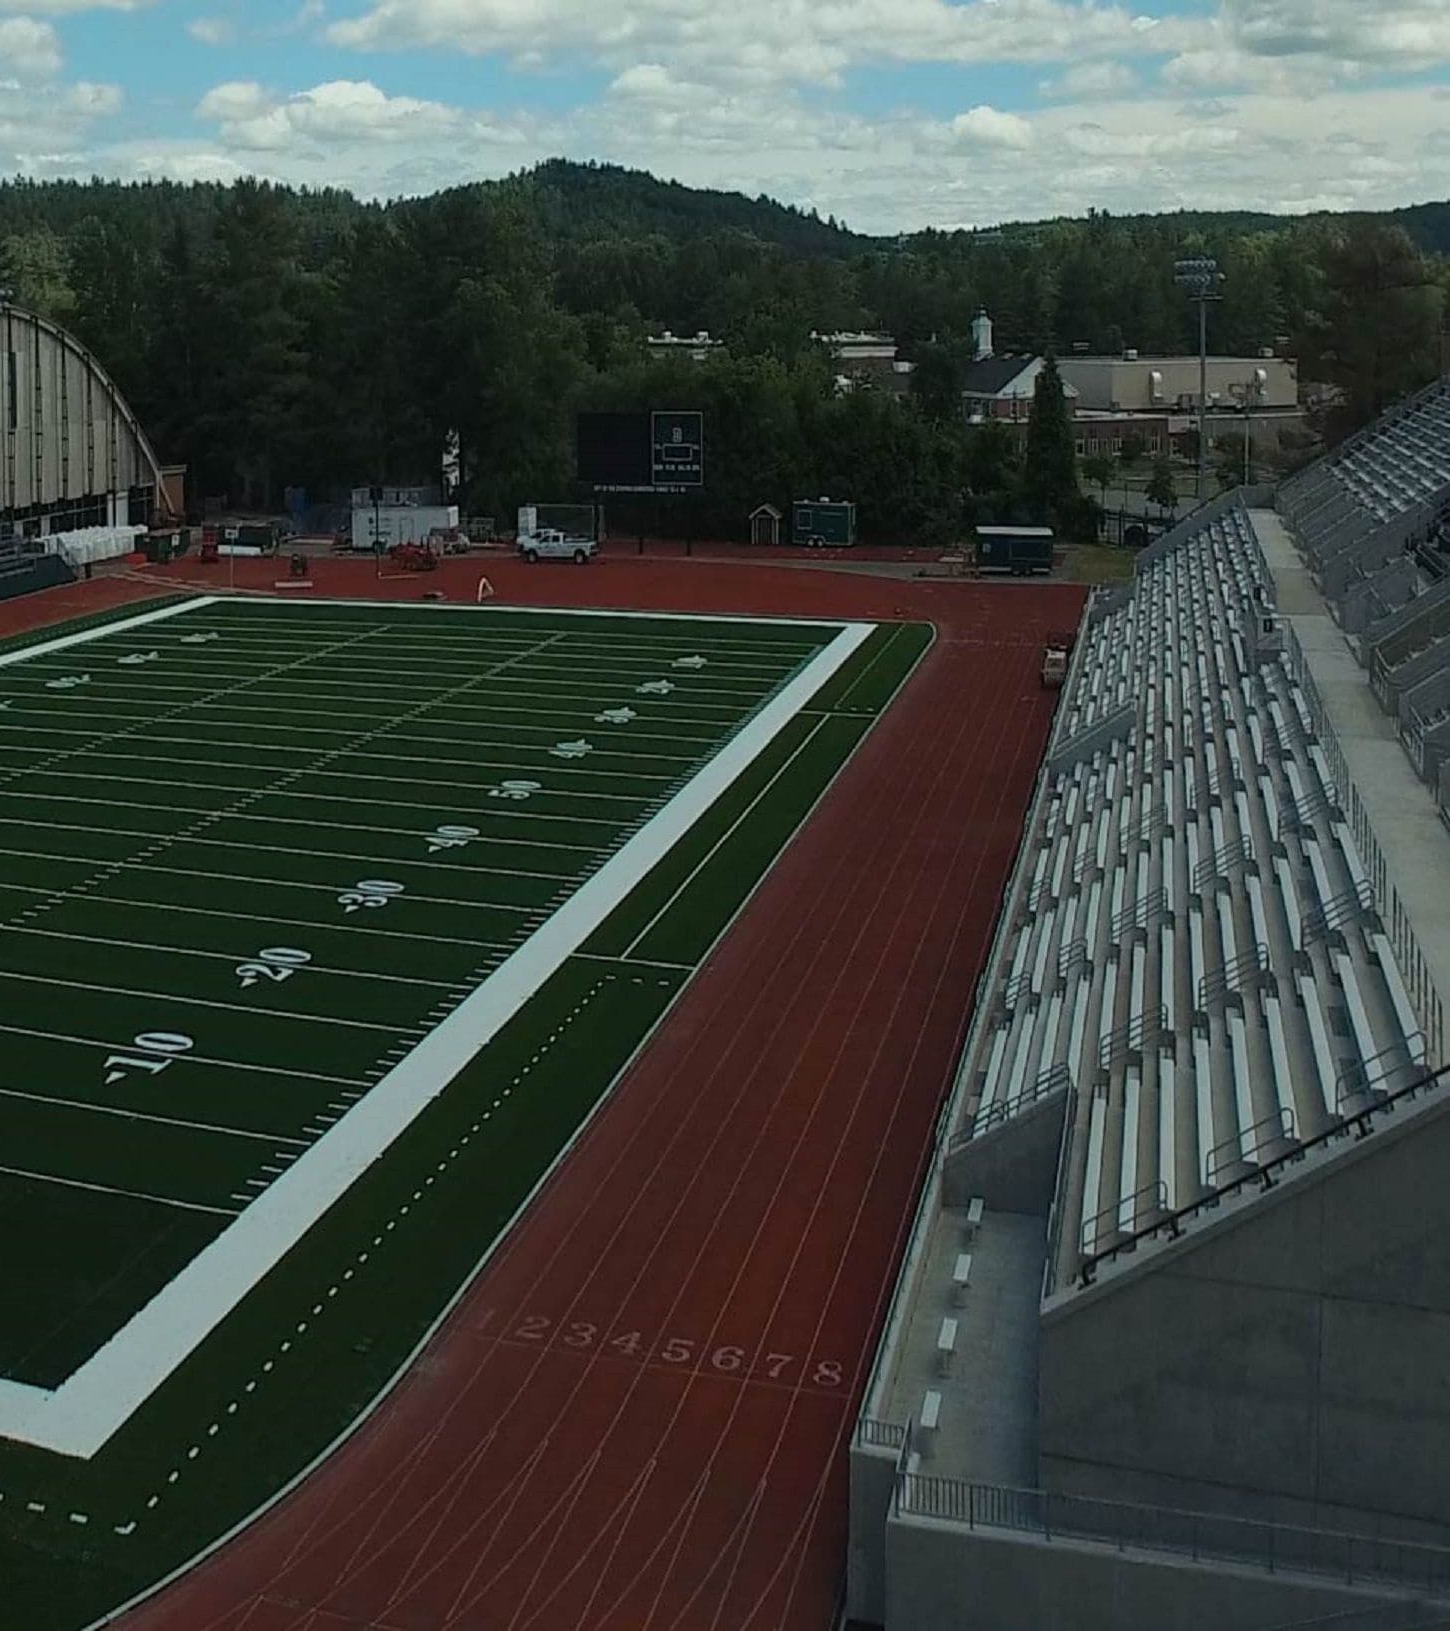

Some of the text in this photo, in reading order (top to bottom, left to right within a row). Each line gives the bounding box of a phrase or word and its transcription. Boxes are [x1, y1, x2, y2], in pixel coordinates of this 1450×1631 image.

[338, 879, 405, 909] 30
[235, 947, 312, 982] 20
[103, 1032, 194, 1075] 10
[515, 1316, 550, 1338] 2
[564, 1322, 597, 1347] 3
[611, 1331, 642, 1354] 4
[661, 1338, 695, 1362] 5
[711, 1346, 745, 1370] 6
[765, 1353, 794, 1378] 7
[813, 1360, 842, 1386] 8
